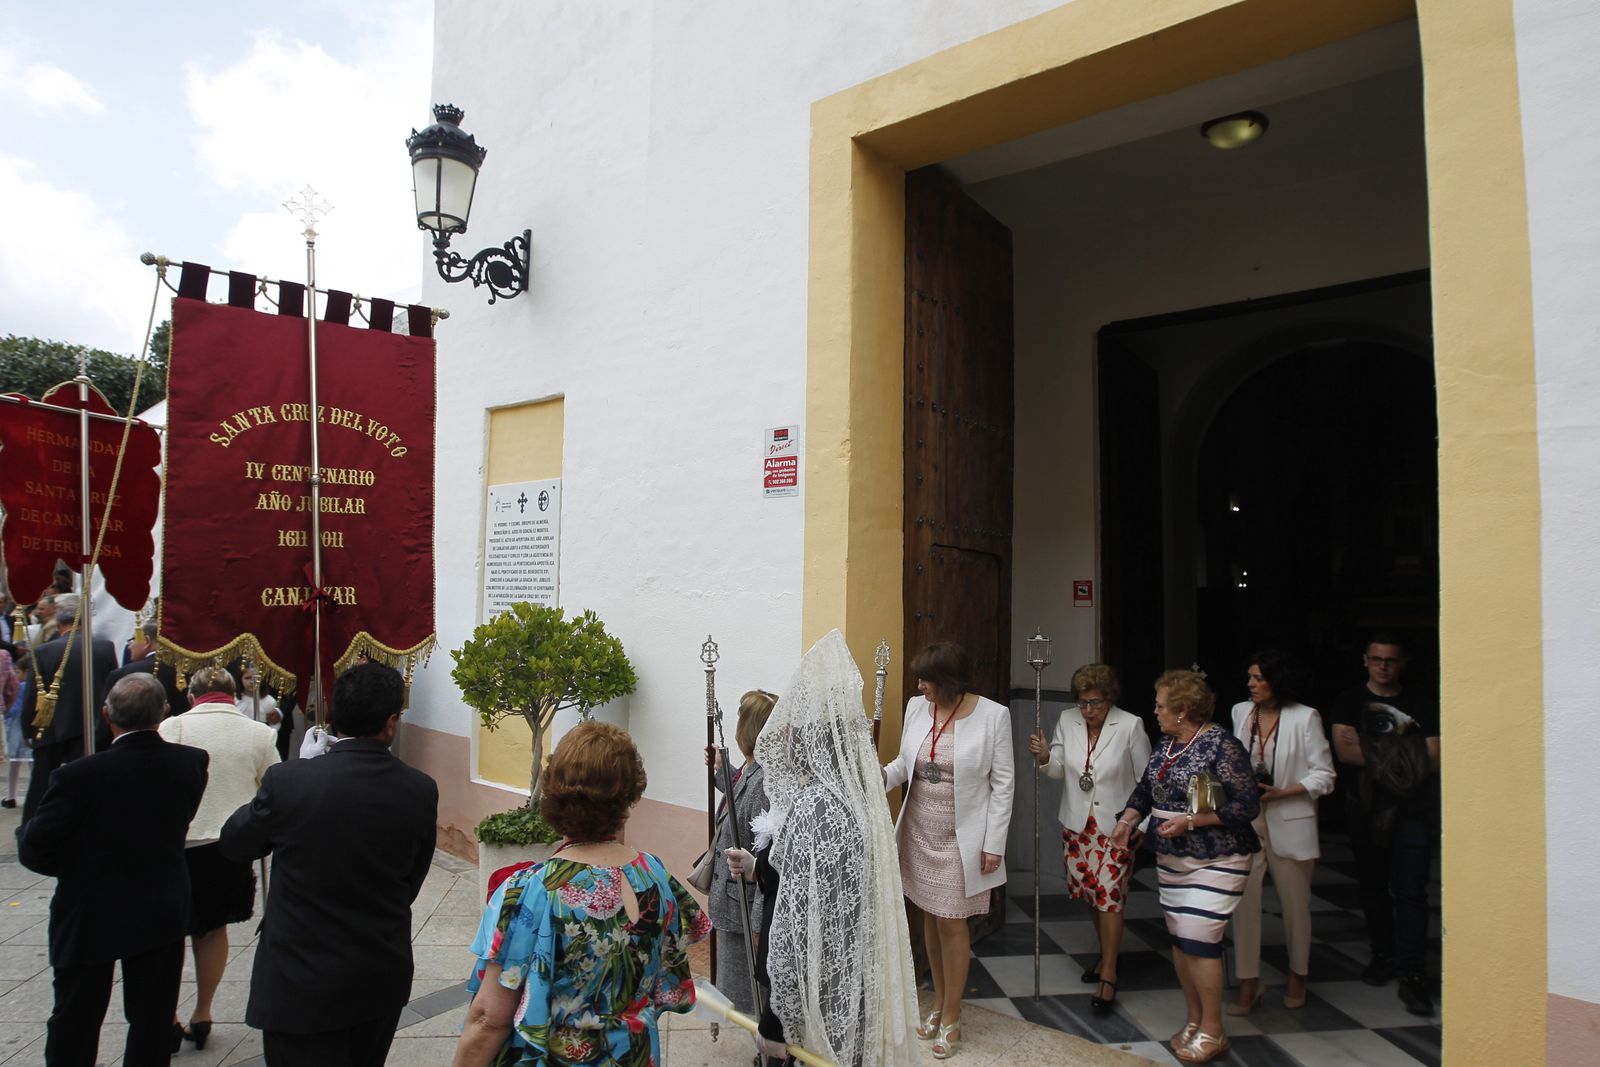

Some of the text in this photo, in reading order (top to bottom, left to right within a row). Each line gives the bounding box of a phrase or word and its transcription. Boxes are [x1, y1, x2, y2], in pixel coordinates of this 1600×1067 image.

[209, 405, 277, 448] SANTA
[329, 407, 363, 432] DEL
[367, 418, 408, 458] VOTO
[52, 459, 72, 474] DE
[244, 461, 266, 480] IV
[766, 459, 796, 468] Alarma
[24, 480, 121, 507] SANTA RUZ
[255, 490, 293, 511] AÑO
[20, 507, 41, 523] DE
[21, 535, 41, 550] DE
[319, 531, 344, 548] 011
